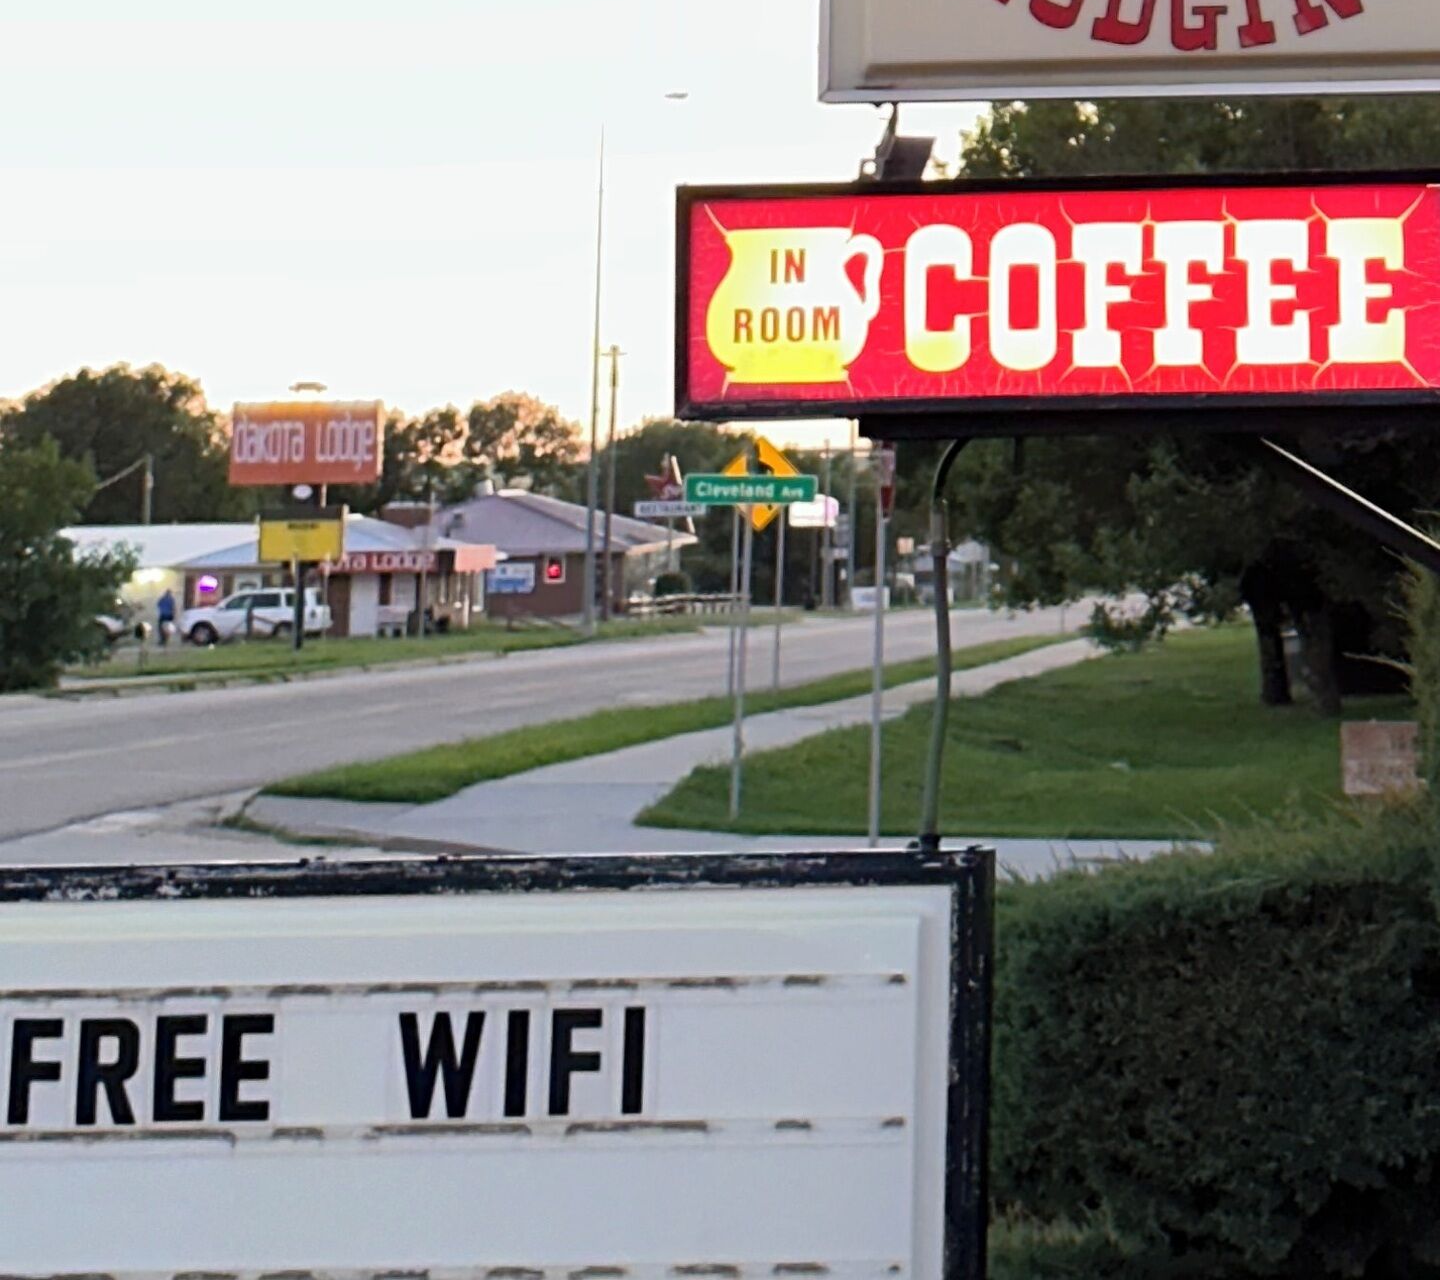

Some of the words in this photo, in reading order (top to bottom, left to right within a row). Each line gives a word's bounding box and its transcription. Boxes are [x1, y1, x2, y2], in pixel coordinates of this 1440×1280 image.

[769, 248, 806, 284] IN
[904, 216, 1405, 373] COFFEE
[733, 306, 842, 344] ROOM
[695, 482, 775, 498] Cleveland
[782, 487, 804, 498] Ave
[6, 1013, 276, 1126] FREE
[398, 1005, 647, 1120] WIFI
